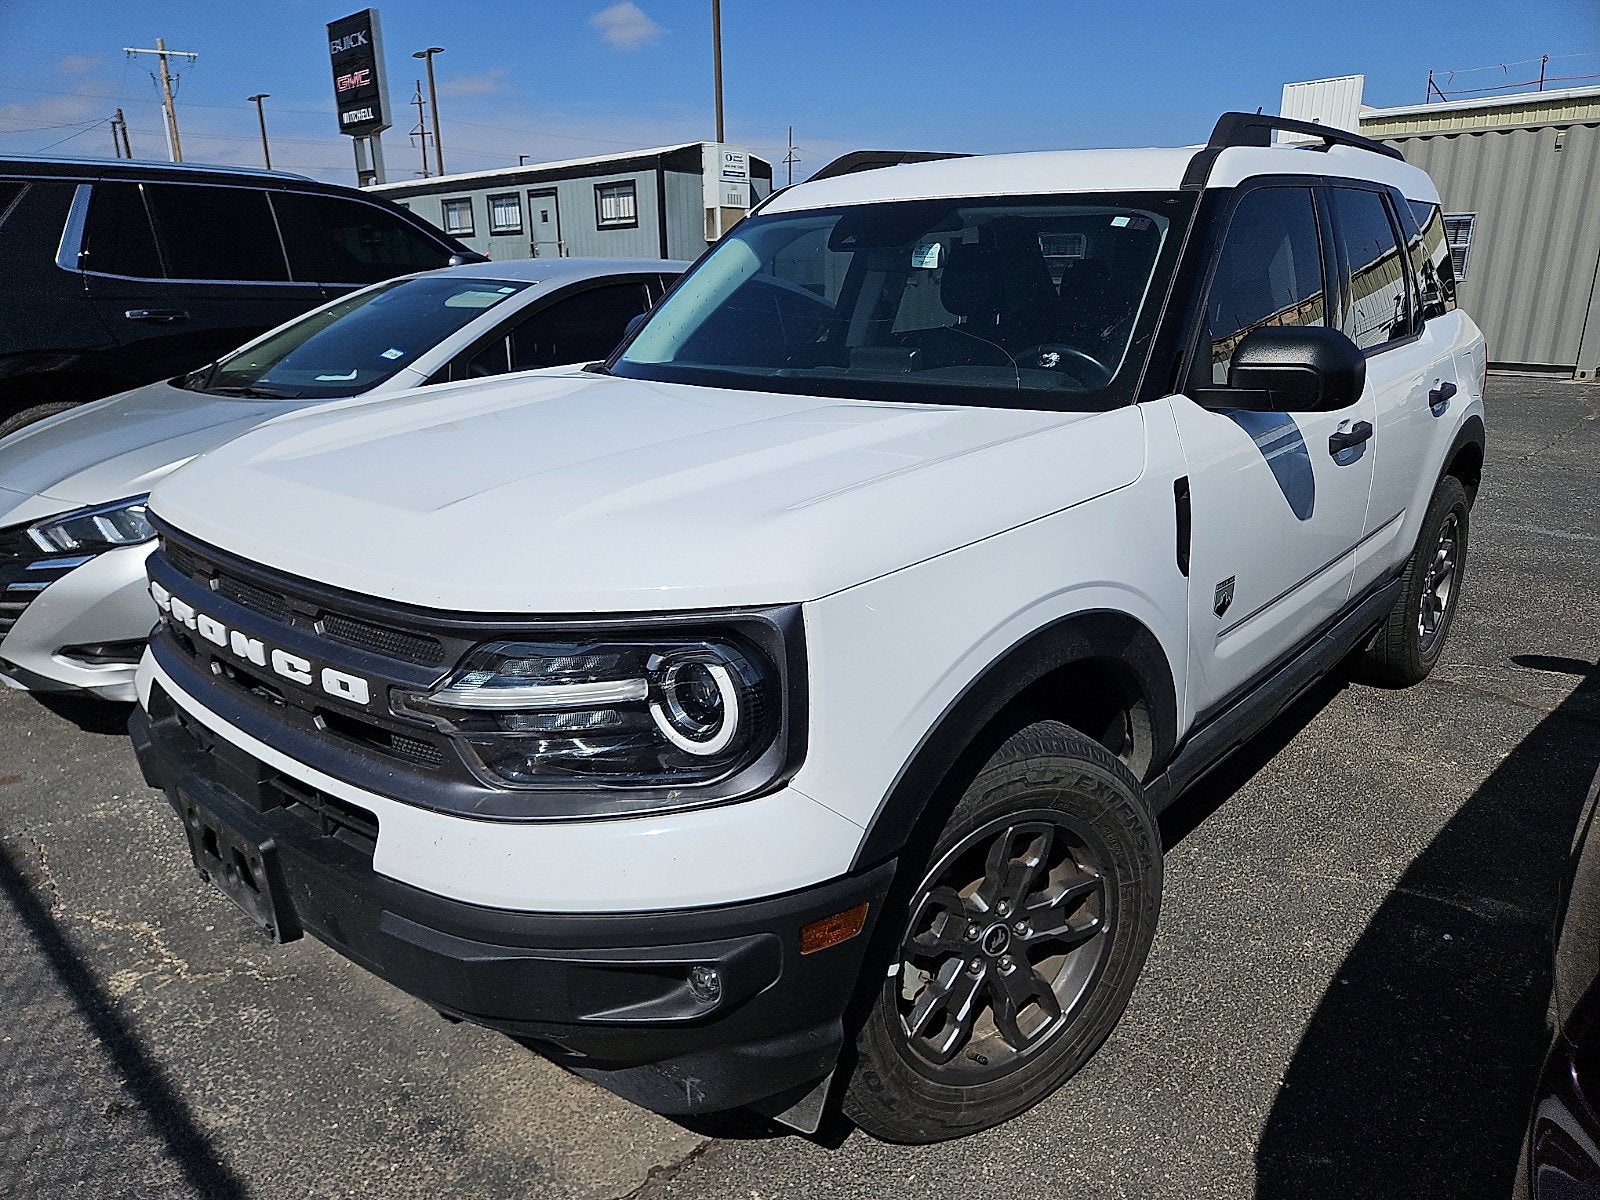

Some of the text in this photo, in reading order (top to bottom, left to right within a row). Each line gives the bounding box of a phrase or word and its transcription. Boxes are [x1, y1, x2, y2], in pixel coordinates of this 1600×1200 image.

[330, 30, 368, 54] BUICK
[336, 69, 370, 92] GMC
[151, 581, 369, 705] BRONCO
